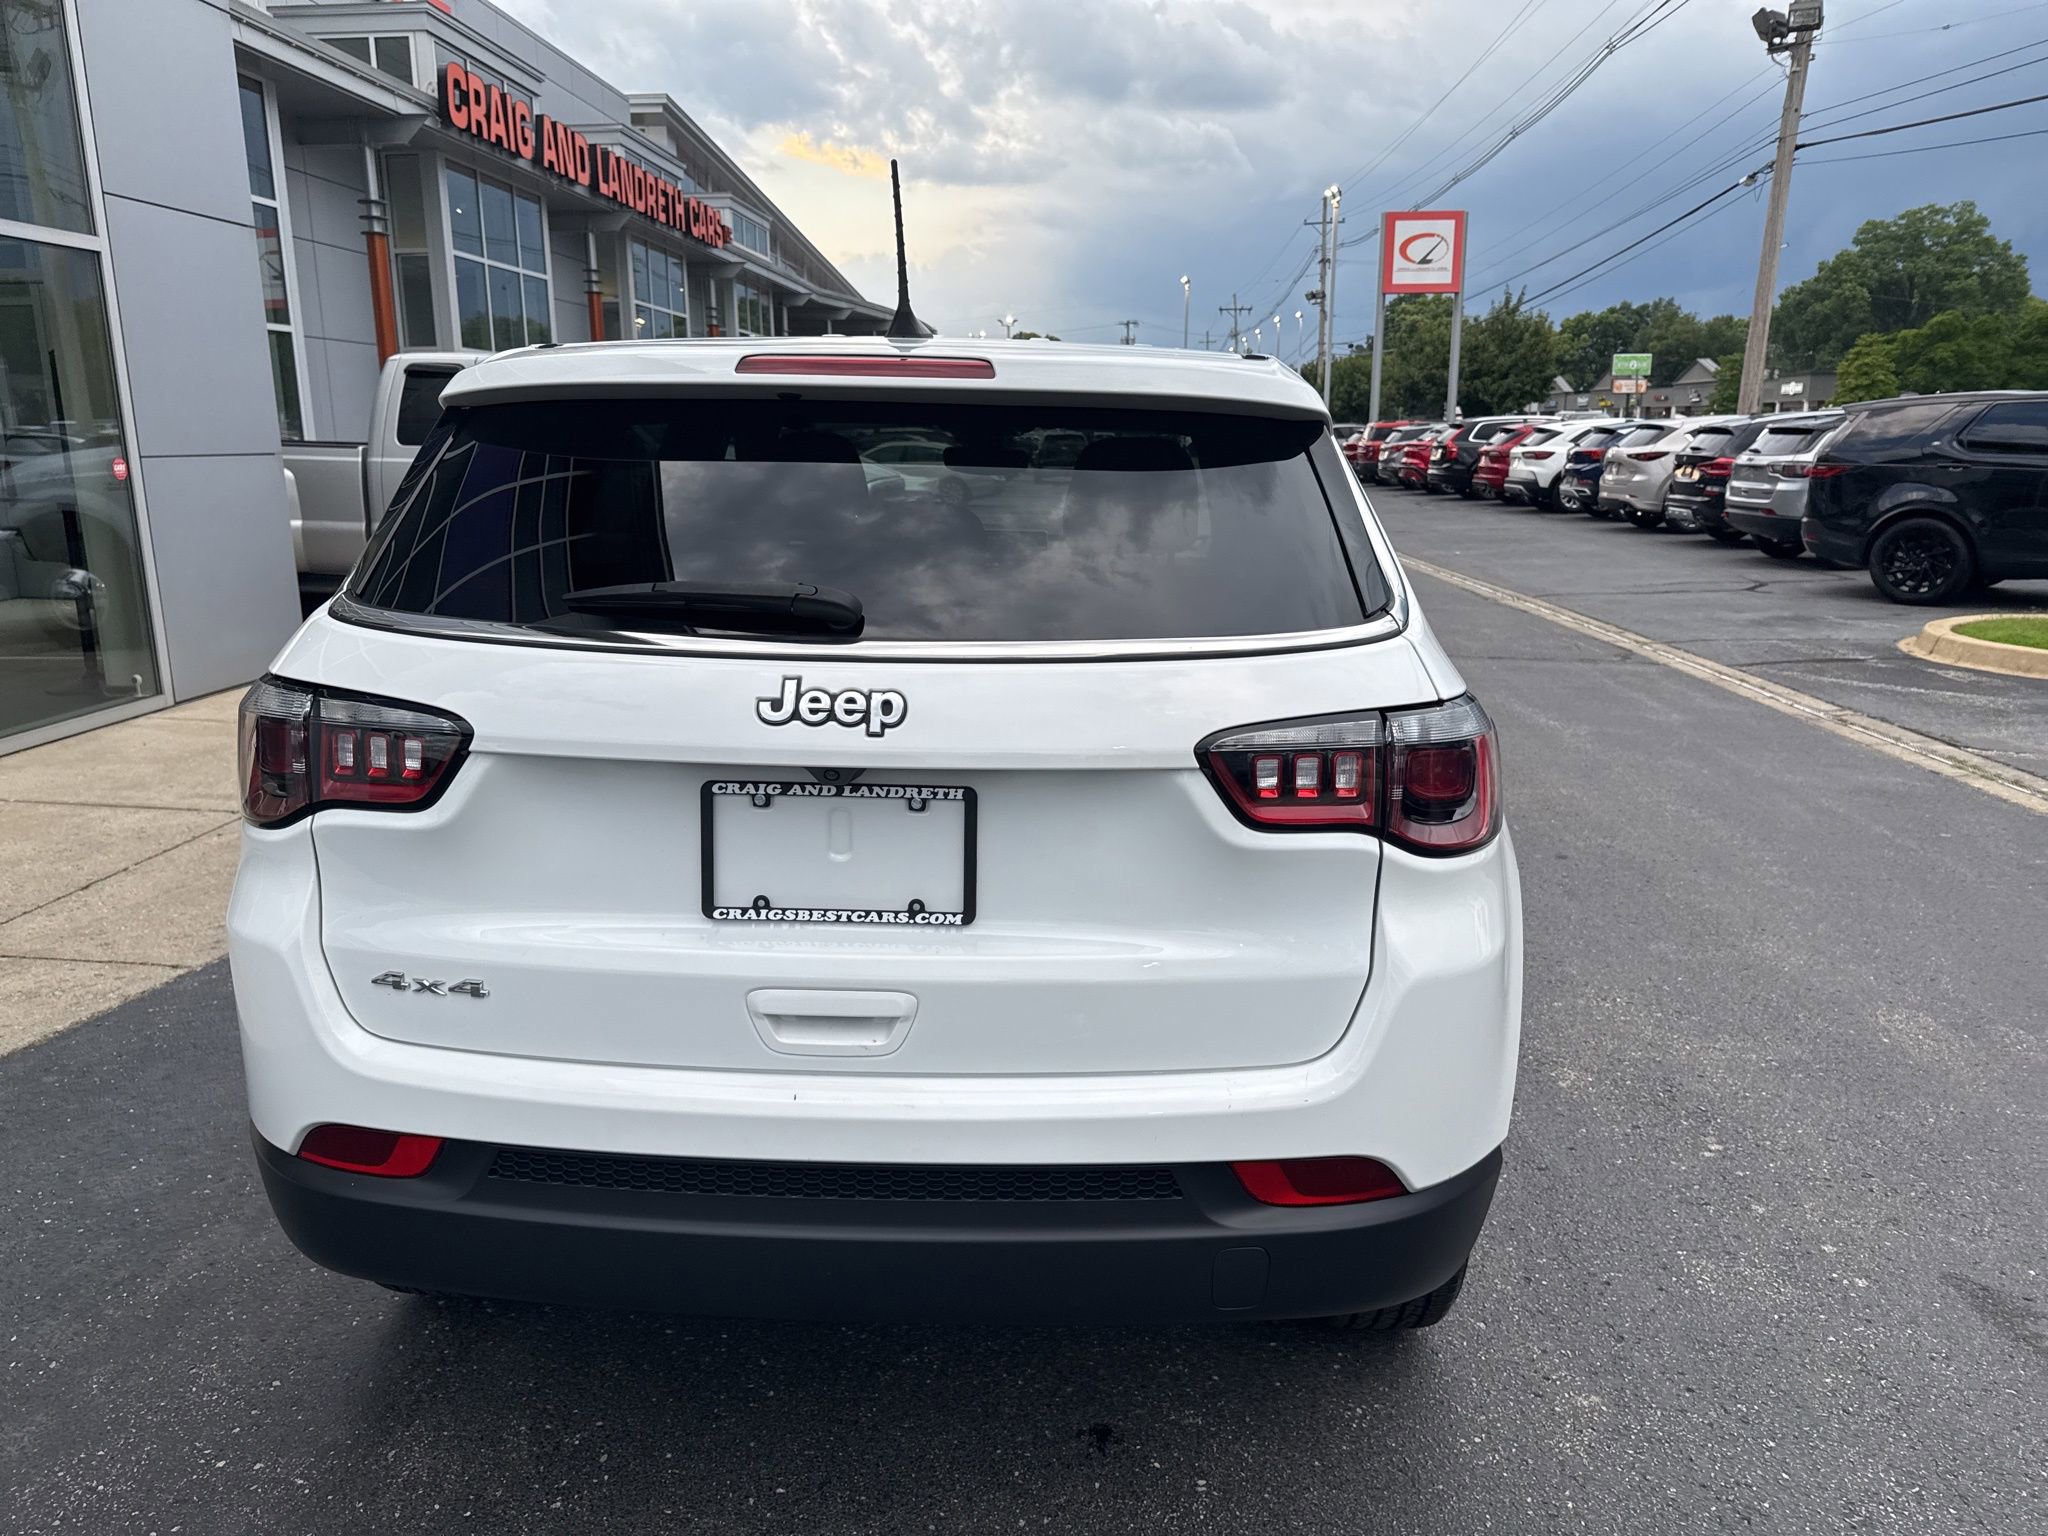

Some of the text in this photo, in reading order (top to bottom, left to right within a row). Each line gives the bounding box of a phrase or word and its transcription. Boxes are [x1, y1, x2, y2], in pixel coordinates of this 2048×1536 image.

[446, 61, 724, 249] CRAIG AND LANDRETH CARS
[756, 676, 907, 737] Jeep
[711, 782, 965, 800] CRAIG AND LANDRETH
[712, 908, 964, 925] CRAIGSBESTCARS.COM
